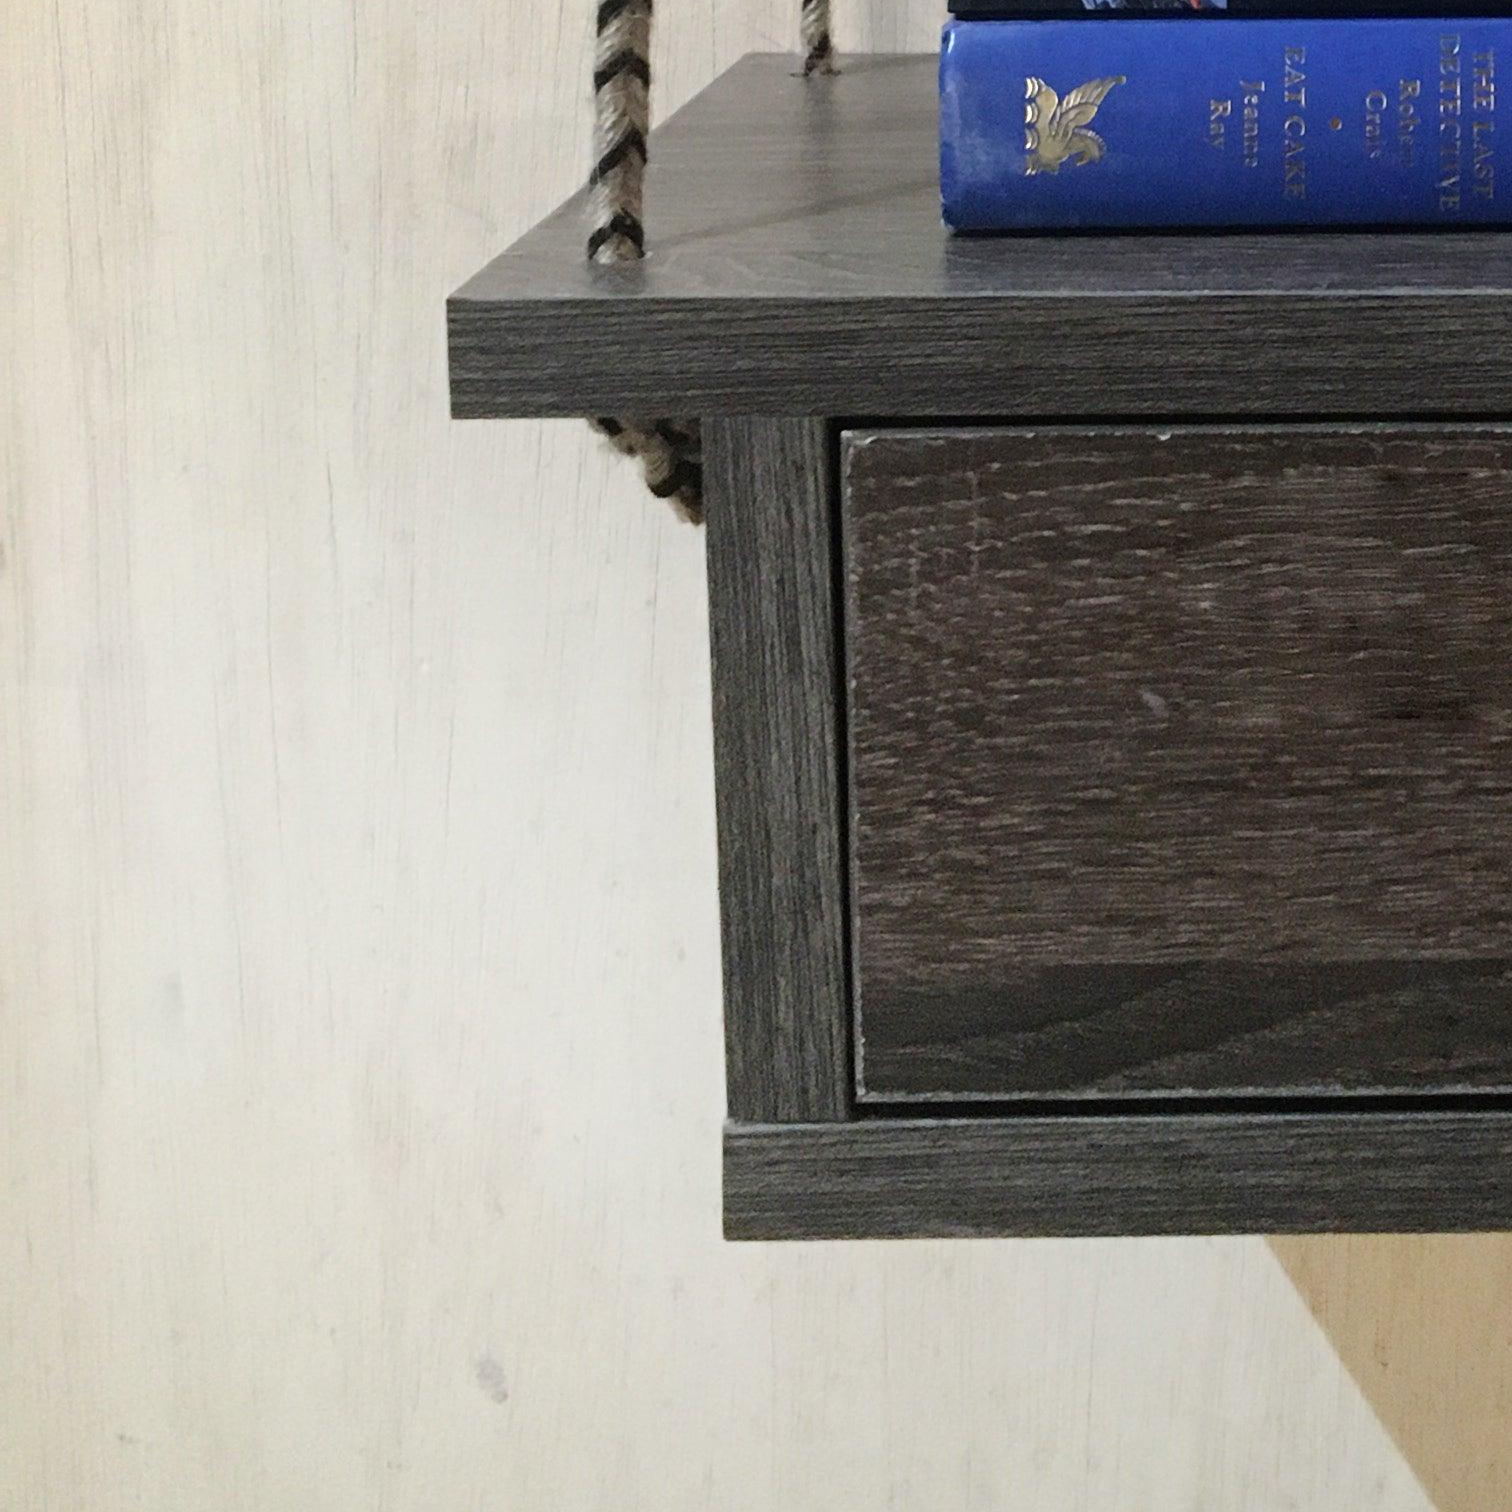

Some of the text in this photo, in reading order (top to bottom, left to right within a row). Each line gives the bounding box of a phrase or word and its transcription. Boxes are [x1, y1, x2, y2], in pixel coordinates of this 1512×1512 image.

[1204, 99, 1231, 150] Ray
[1283, 46, 1306, 199] EAT CAKE
[1436, 33, 1461, 211] DETECTIVE
[1473, 50, 1495, 199] THE LAST
